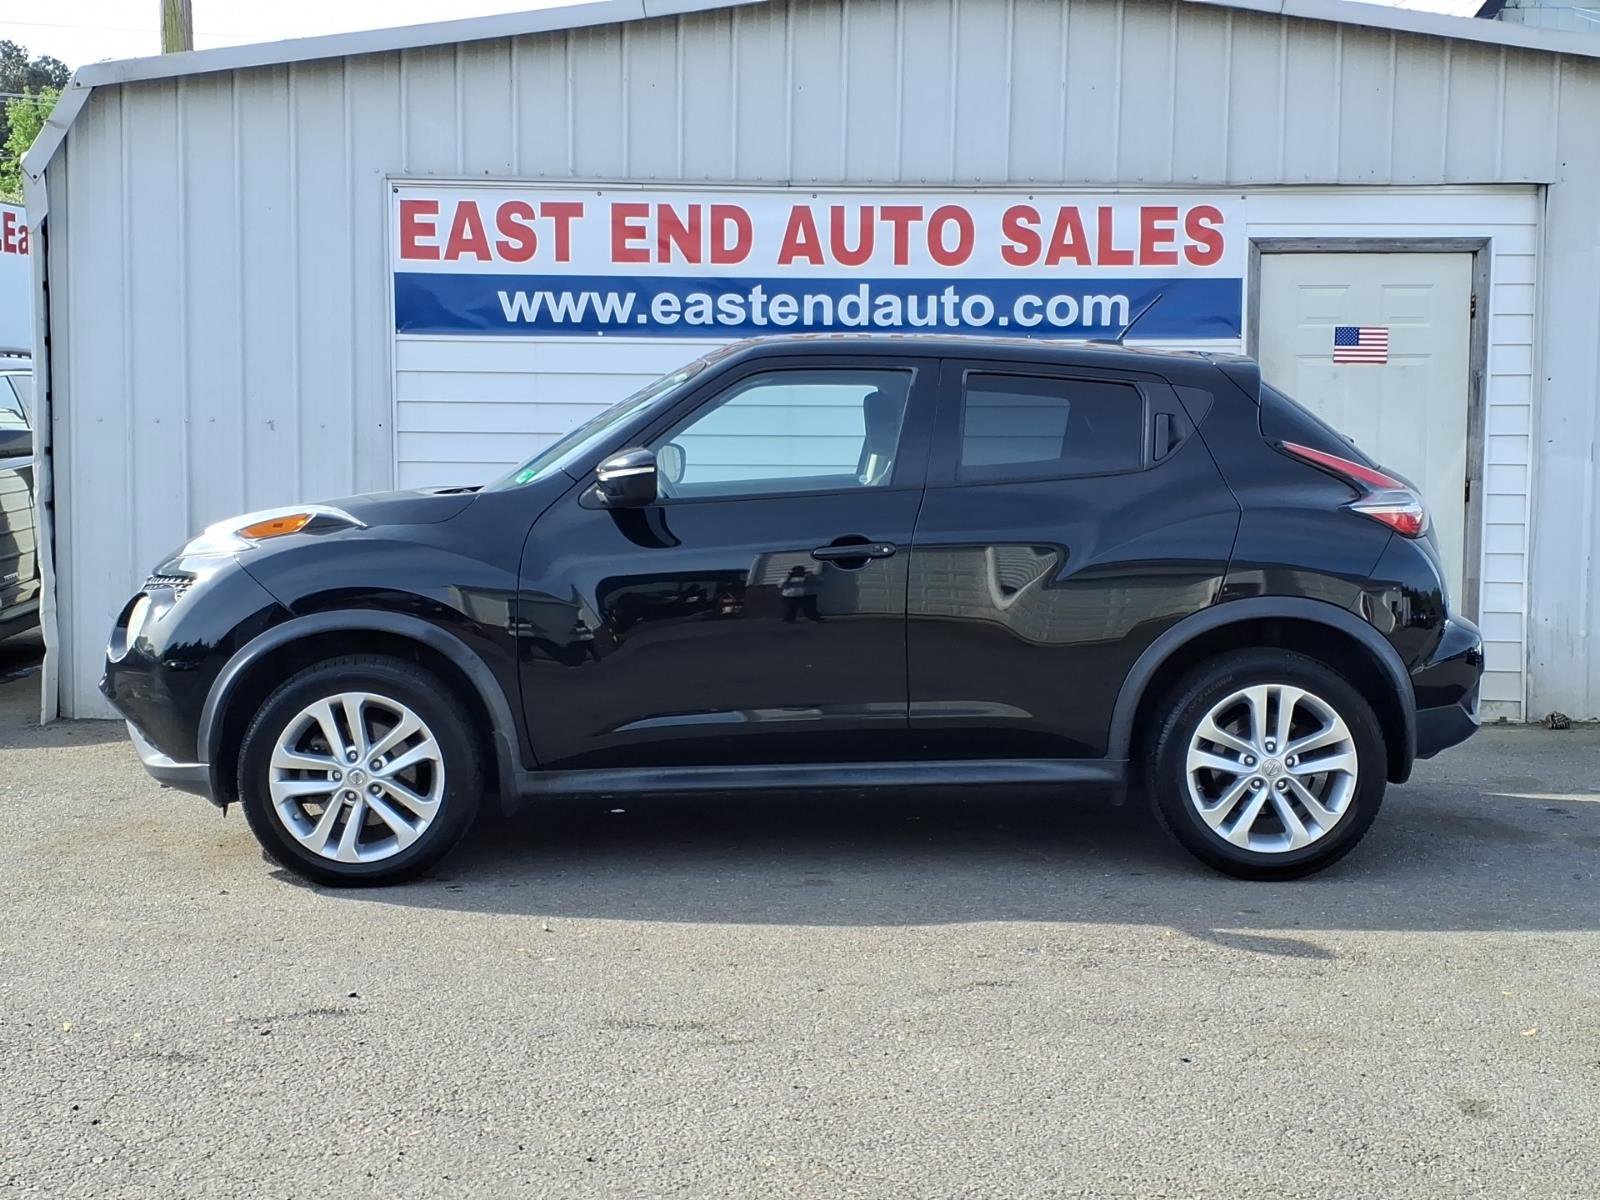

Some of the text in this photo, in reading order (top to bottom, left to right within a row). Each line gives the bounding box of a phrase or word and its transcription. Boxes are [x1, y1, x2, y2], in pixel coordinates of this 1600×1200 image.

[399, 199, 1226, 267] EAST END AUTO SALES
[497, 283, 1130, 327] www.eastendauto.com
